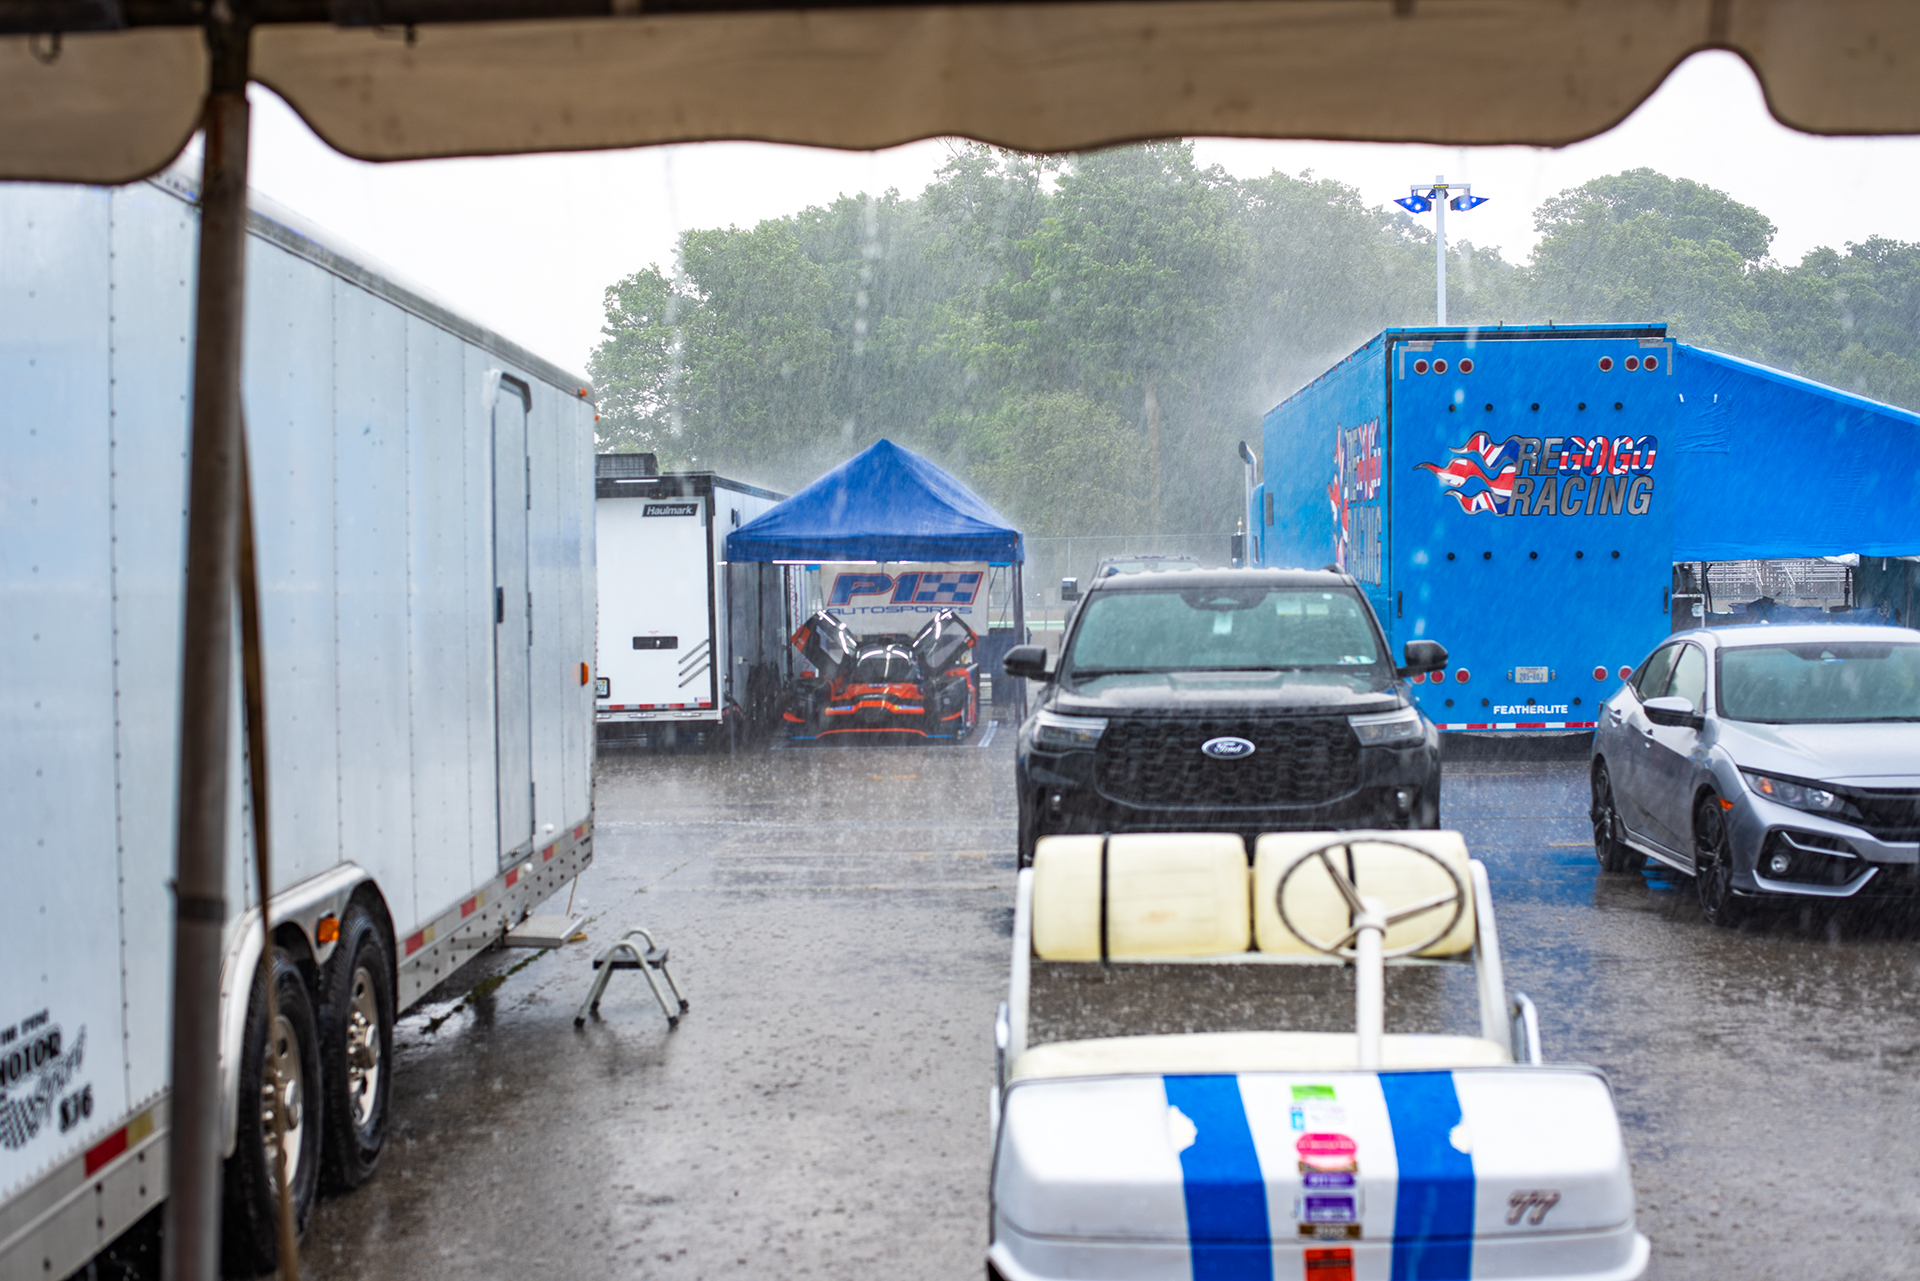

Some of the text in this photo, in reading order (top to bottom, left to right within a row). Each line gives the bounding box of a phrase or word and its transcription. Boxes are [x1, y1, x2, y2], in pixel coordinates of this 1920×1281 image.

[1514, 435, 1658, 477] REGOGO
[1505, 475, 1654, 517] RACING
[646, 505, 693, 516] Haulmark
[826, 605, 973, 616] AUTOSPORTS
[1493, 704, 1569, 715] FEATHERLITE
[1213, 741, 1244, 755] Ford
[1504, 1189, 1561, 1227] 77
